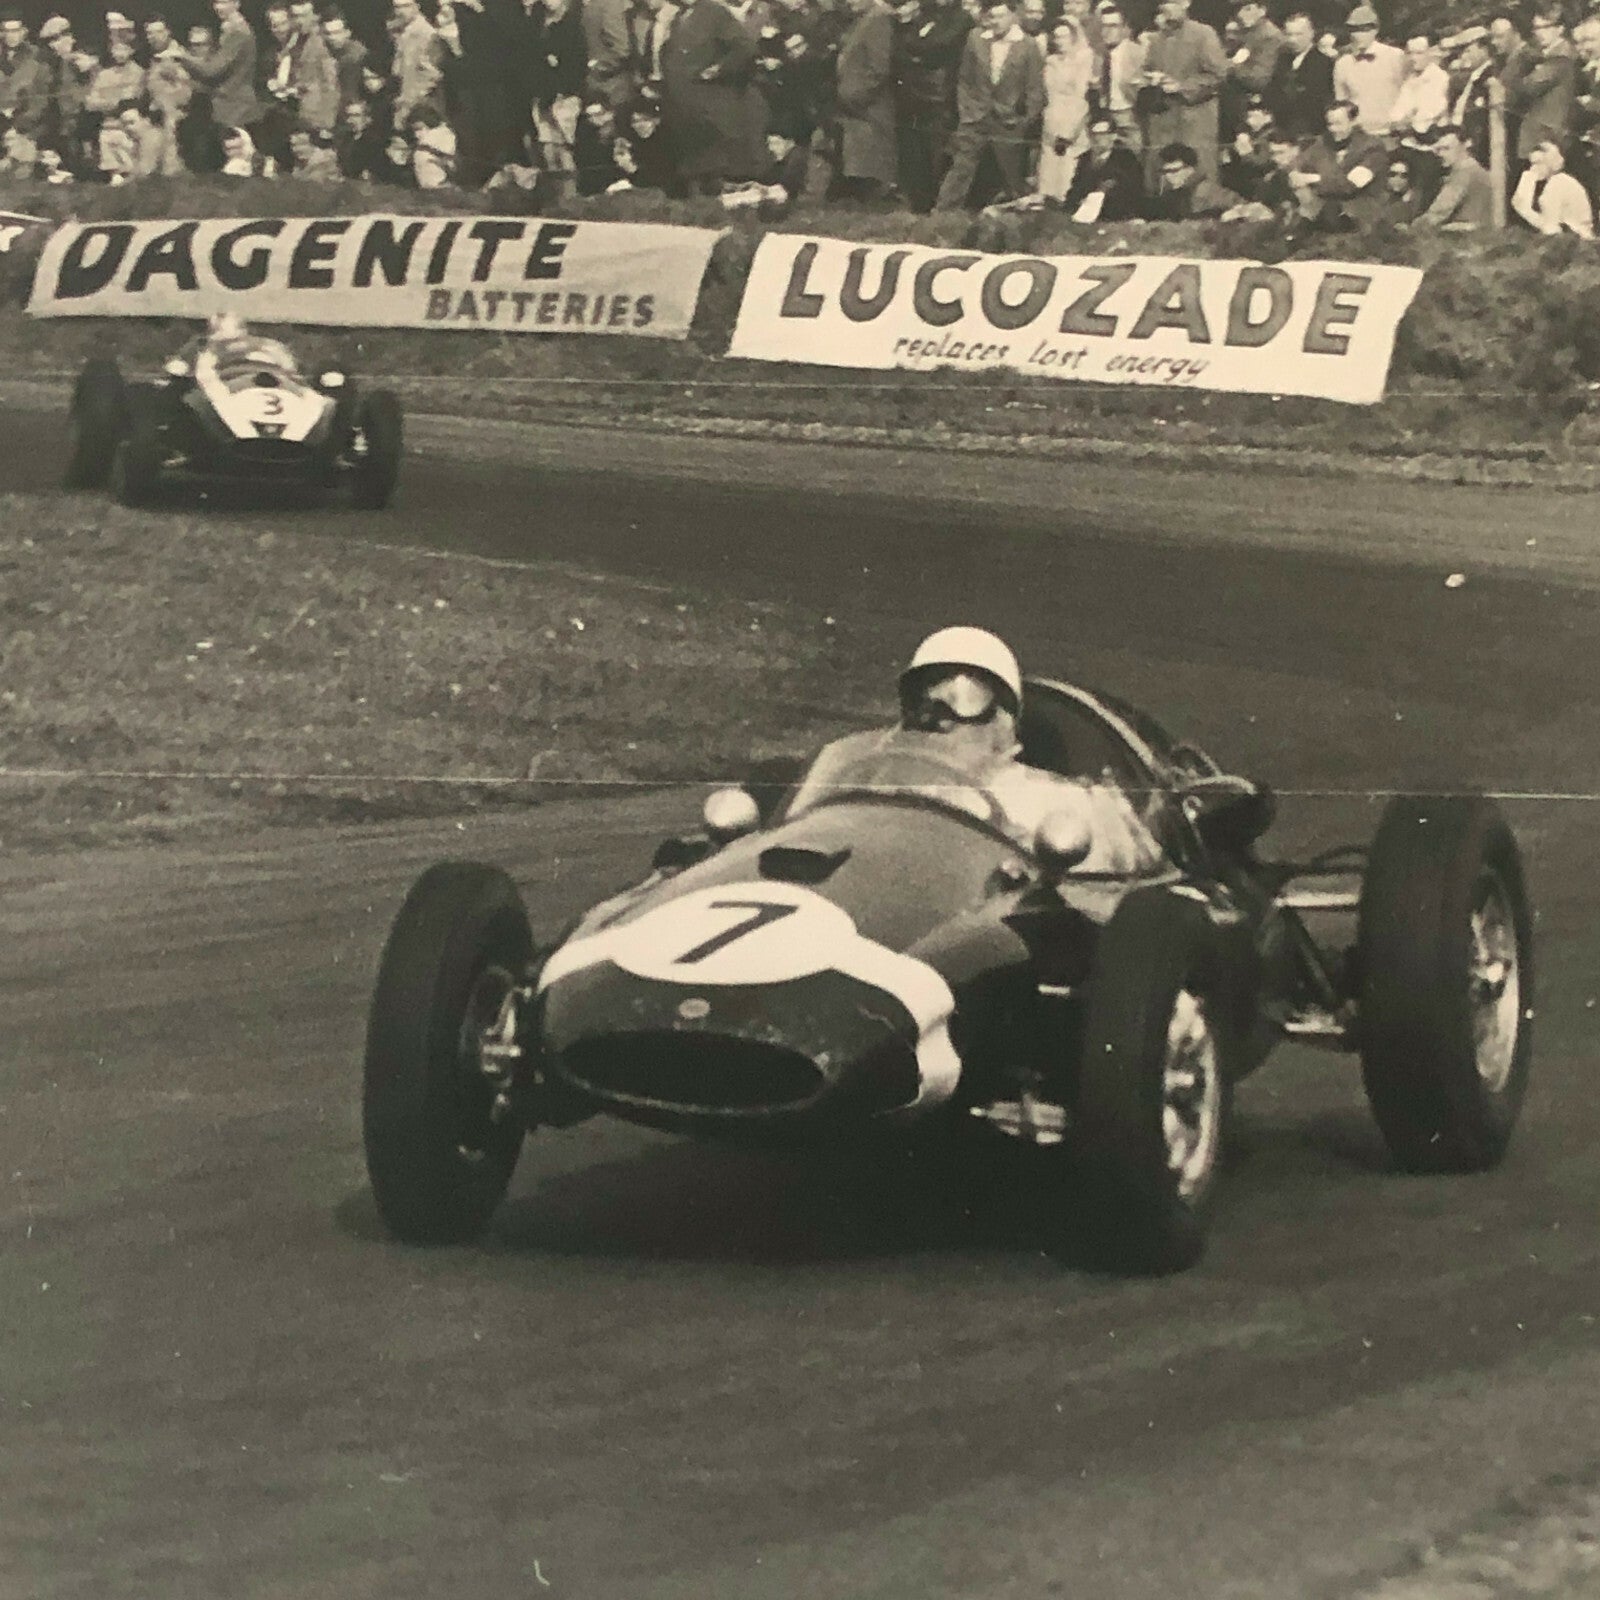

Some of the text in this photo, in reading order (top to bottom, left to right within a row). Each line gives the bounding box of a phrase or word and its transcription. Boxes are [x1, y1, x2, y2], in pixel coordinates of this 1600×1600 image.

[56, 219, 578, 299] DAGENITE
[425, 288, 654, 327] BATTERIES
[780, 242, 1373, 356] LUCOZADE
[892, 333, 1211, 382] replaces lost energy
[263, 392, 284, 415] 3
[673, 901, 800, 964] 7
